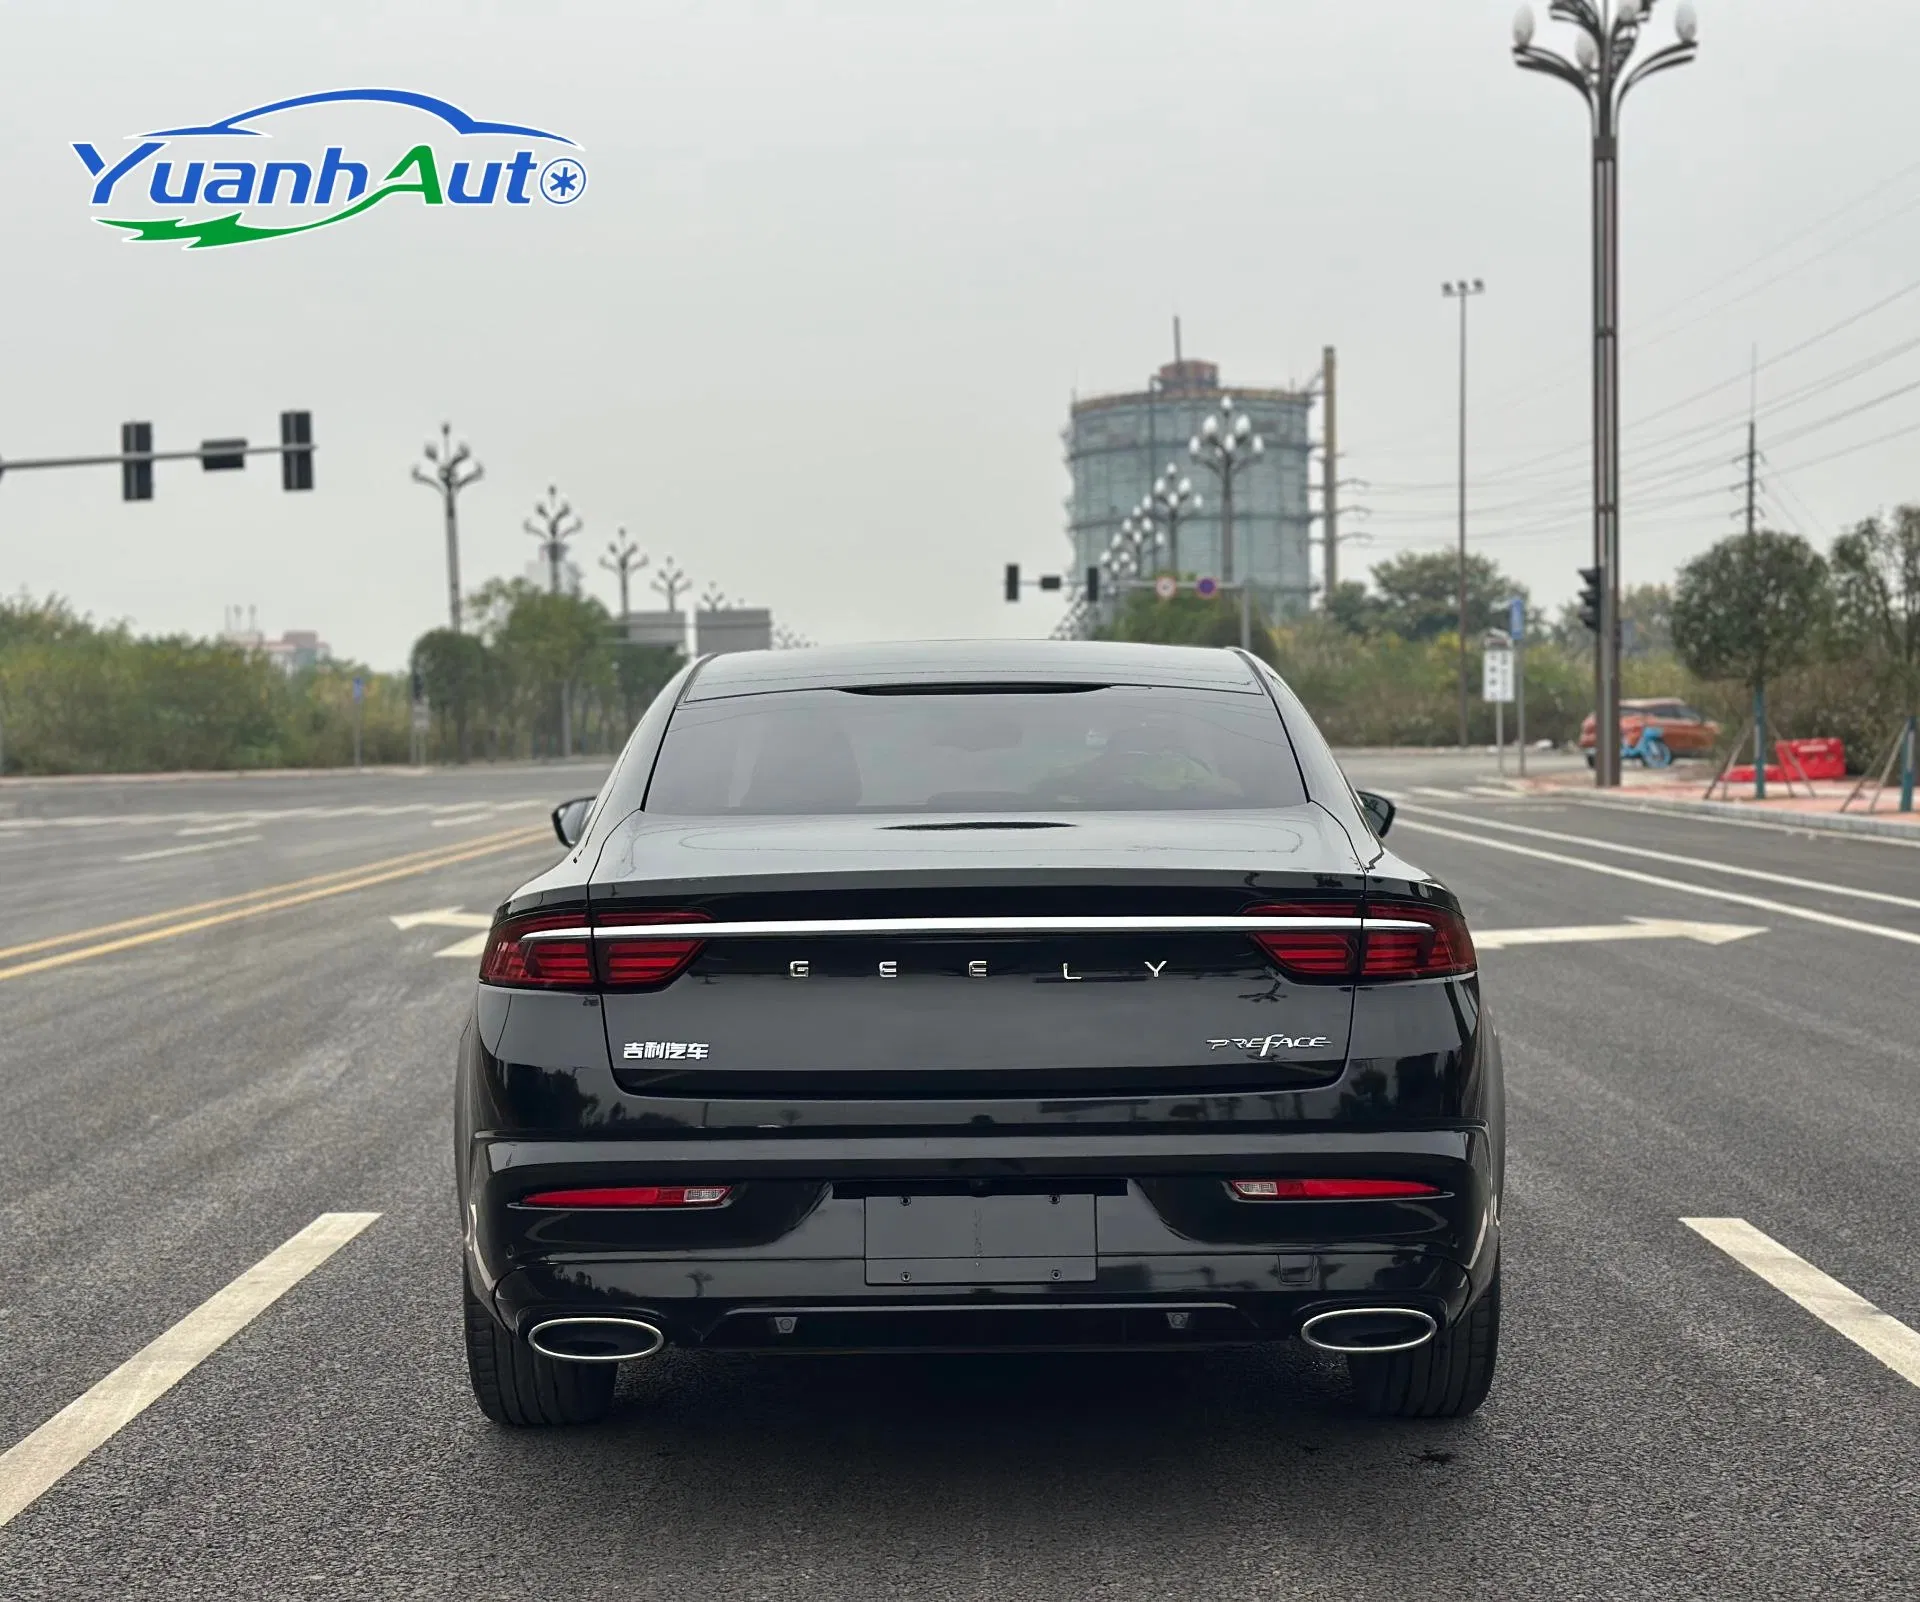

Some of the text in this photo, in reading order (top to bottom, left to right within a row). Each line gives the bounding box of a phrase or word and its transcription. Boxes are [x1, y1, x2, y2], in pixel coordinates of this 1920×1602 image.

[789, 960, 1167, 980] GEELY
[623, 1041, 709, 1060] 吉利汽车
